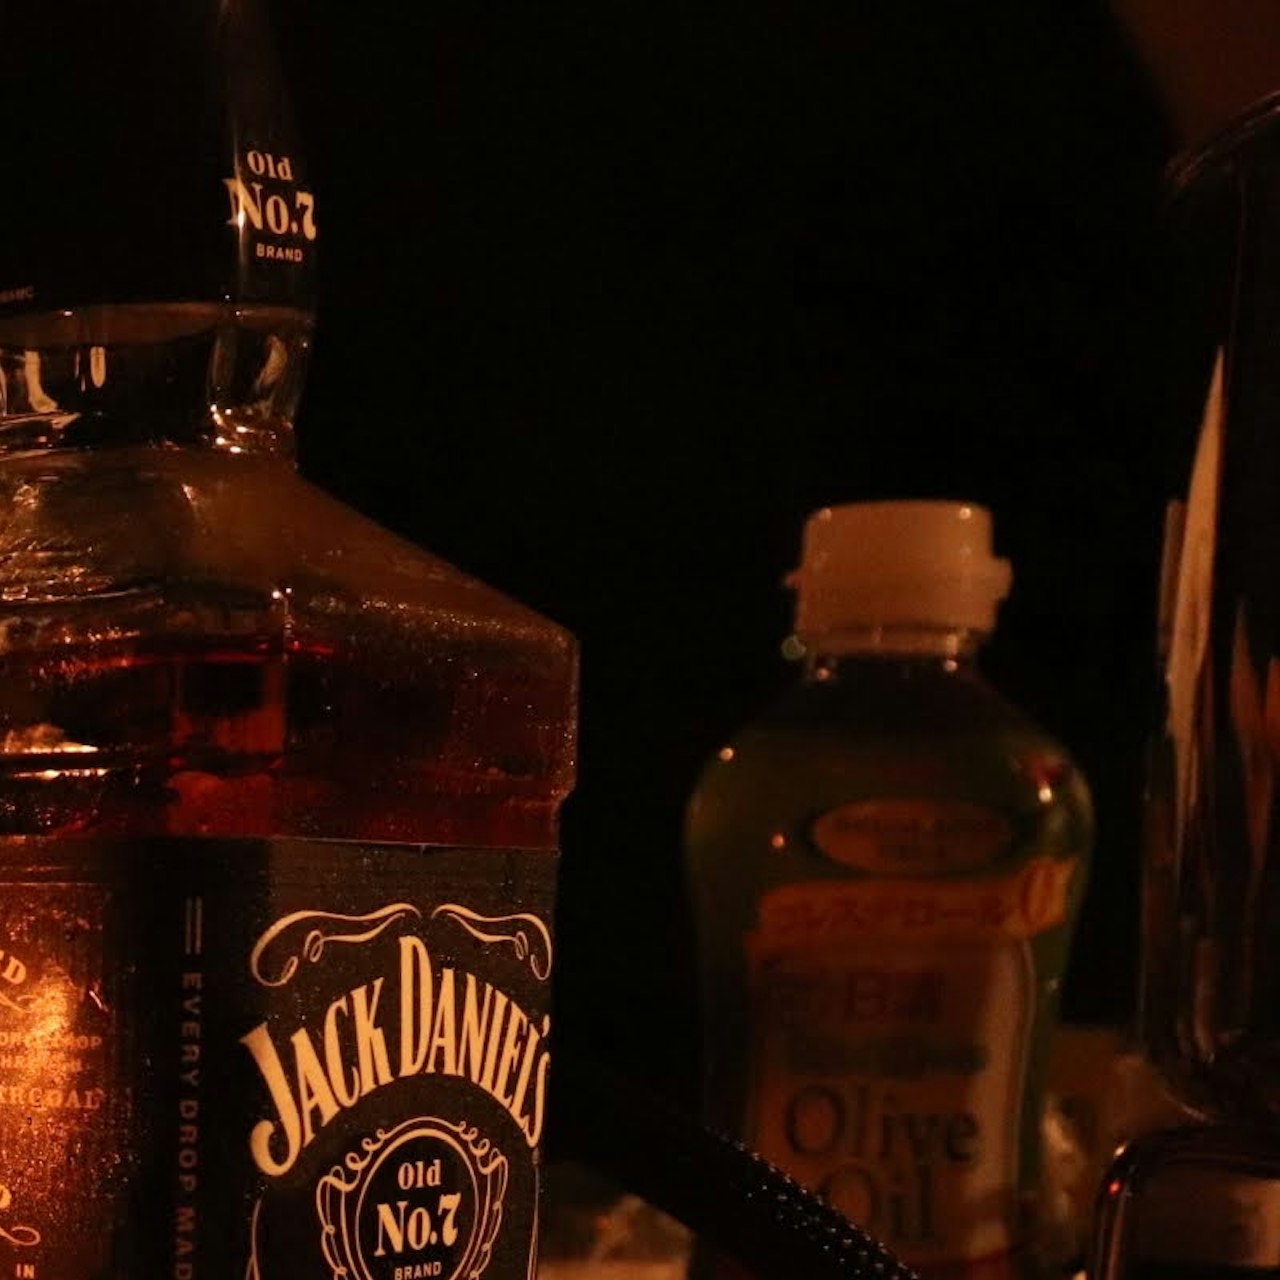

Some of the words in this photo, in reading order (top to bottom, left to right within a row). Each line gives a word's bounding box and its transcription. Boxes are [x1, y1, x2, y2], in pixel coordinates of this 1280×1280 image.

[247, 150, 292, 181] Old
[224, 178, 317, 240] No.7
[256, 243, 303, 262] BRAND
[51, 1033, 103, 1050] OP
[179, 971, 203, 1087] EVERY
[240, 976, 394, 1176] JACK
[399, 935, 550, 1147] DANIEL'S
[177, 1099, 199, 1192] DROP
[785, 1084, 978, 1162] Olive
[397, 1160, 441, 1190] Old
[817, 1165, 936, 1242] Oil
[374, 1193, 461, 1257] No.7
[16, 1263, 35, 1280] IN
